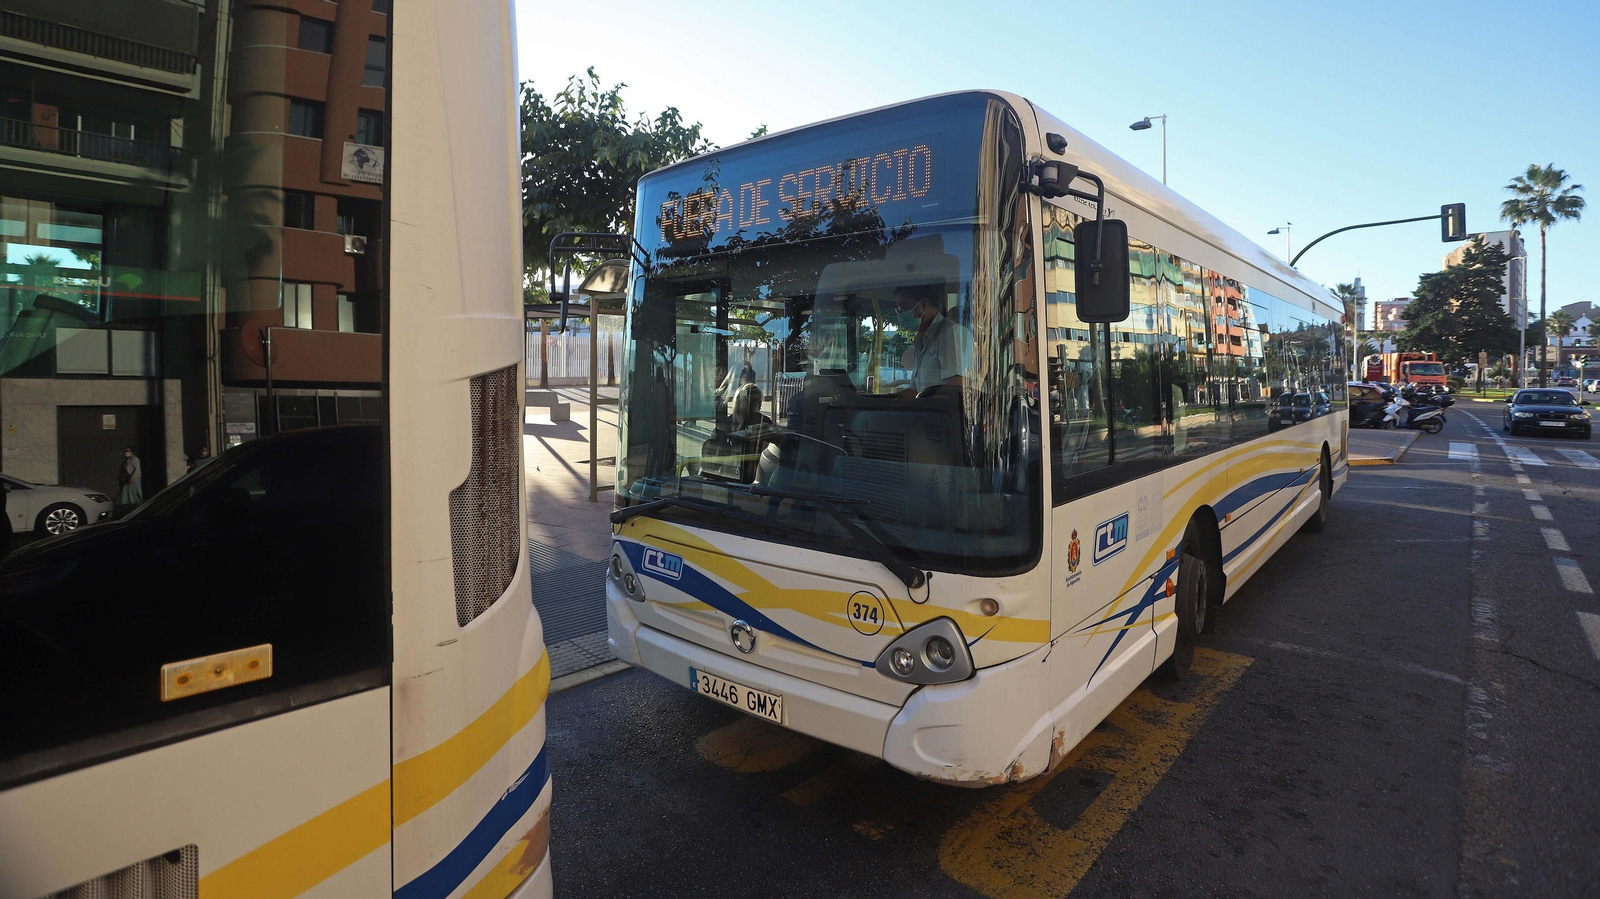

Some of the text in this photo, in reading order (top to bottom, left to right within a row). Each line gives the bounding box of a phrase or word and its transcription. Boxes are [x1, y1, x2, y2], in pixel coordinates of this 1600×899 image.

[660, 144, 931, 242] FUERA DE SERVICIO
[852, 602, 878, 624] 374
[702, 675, 738, 705] 3446
[747, 691, 778, 719] GMX
